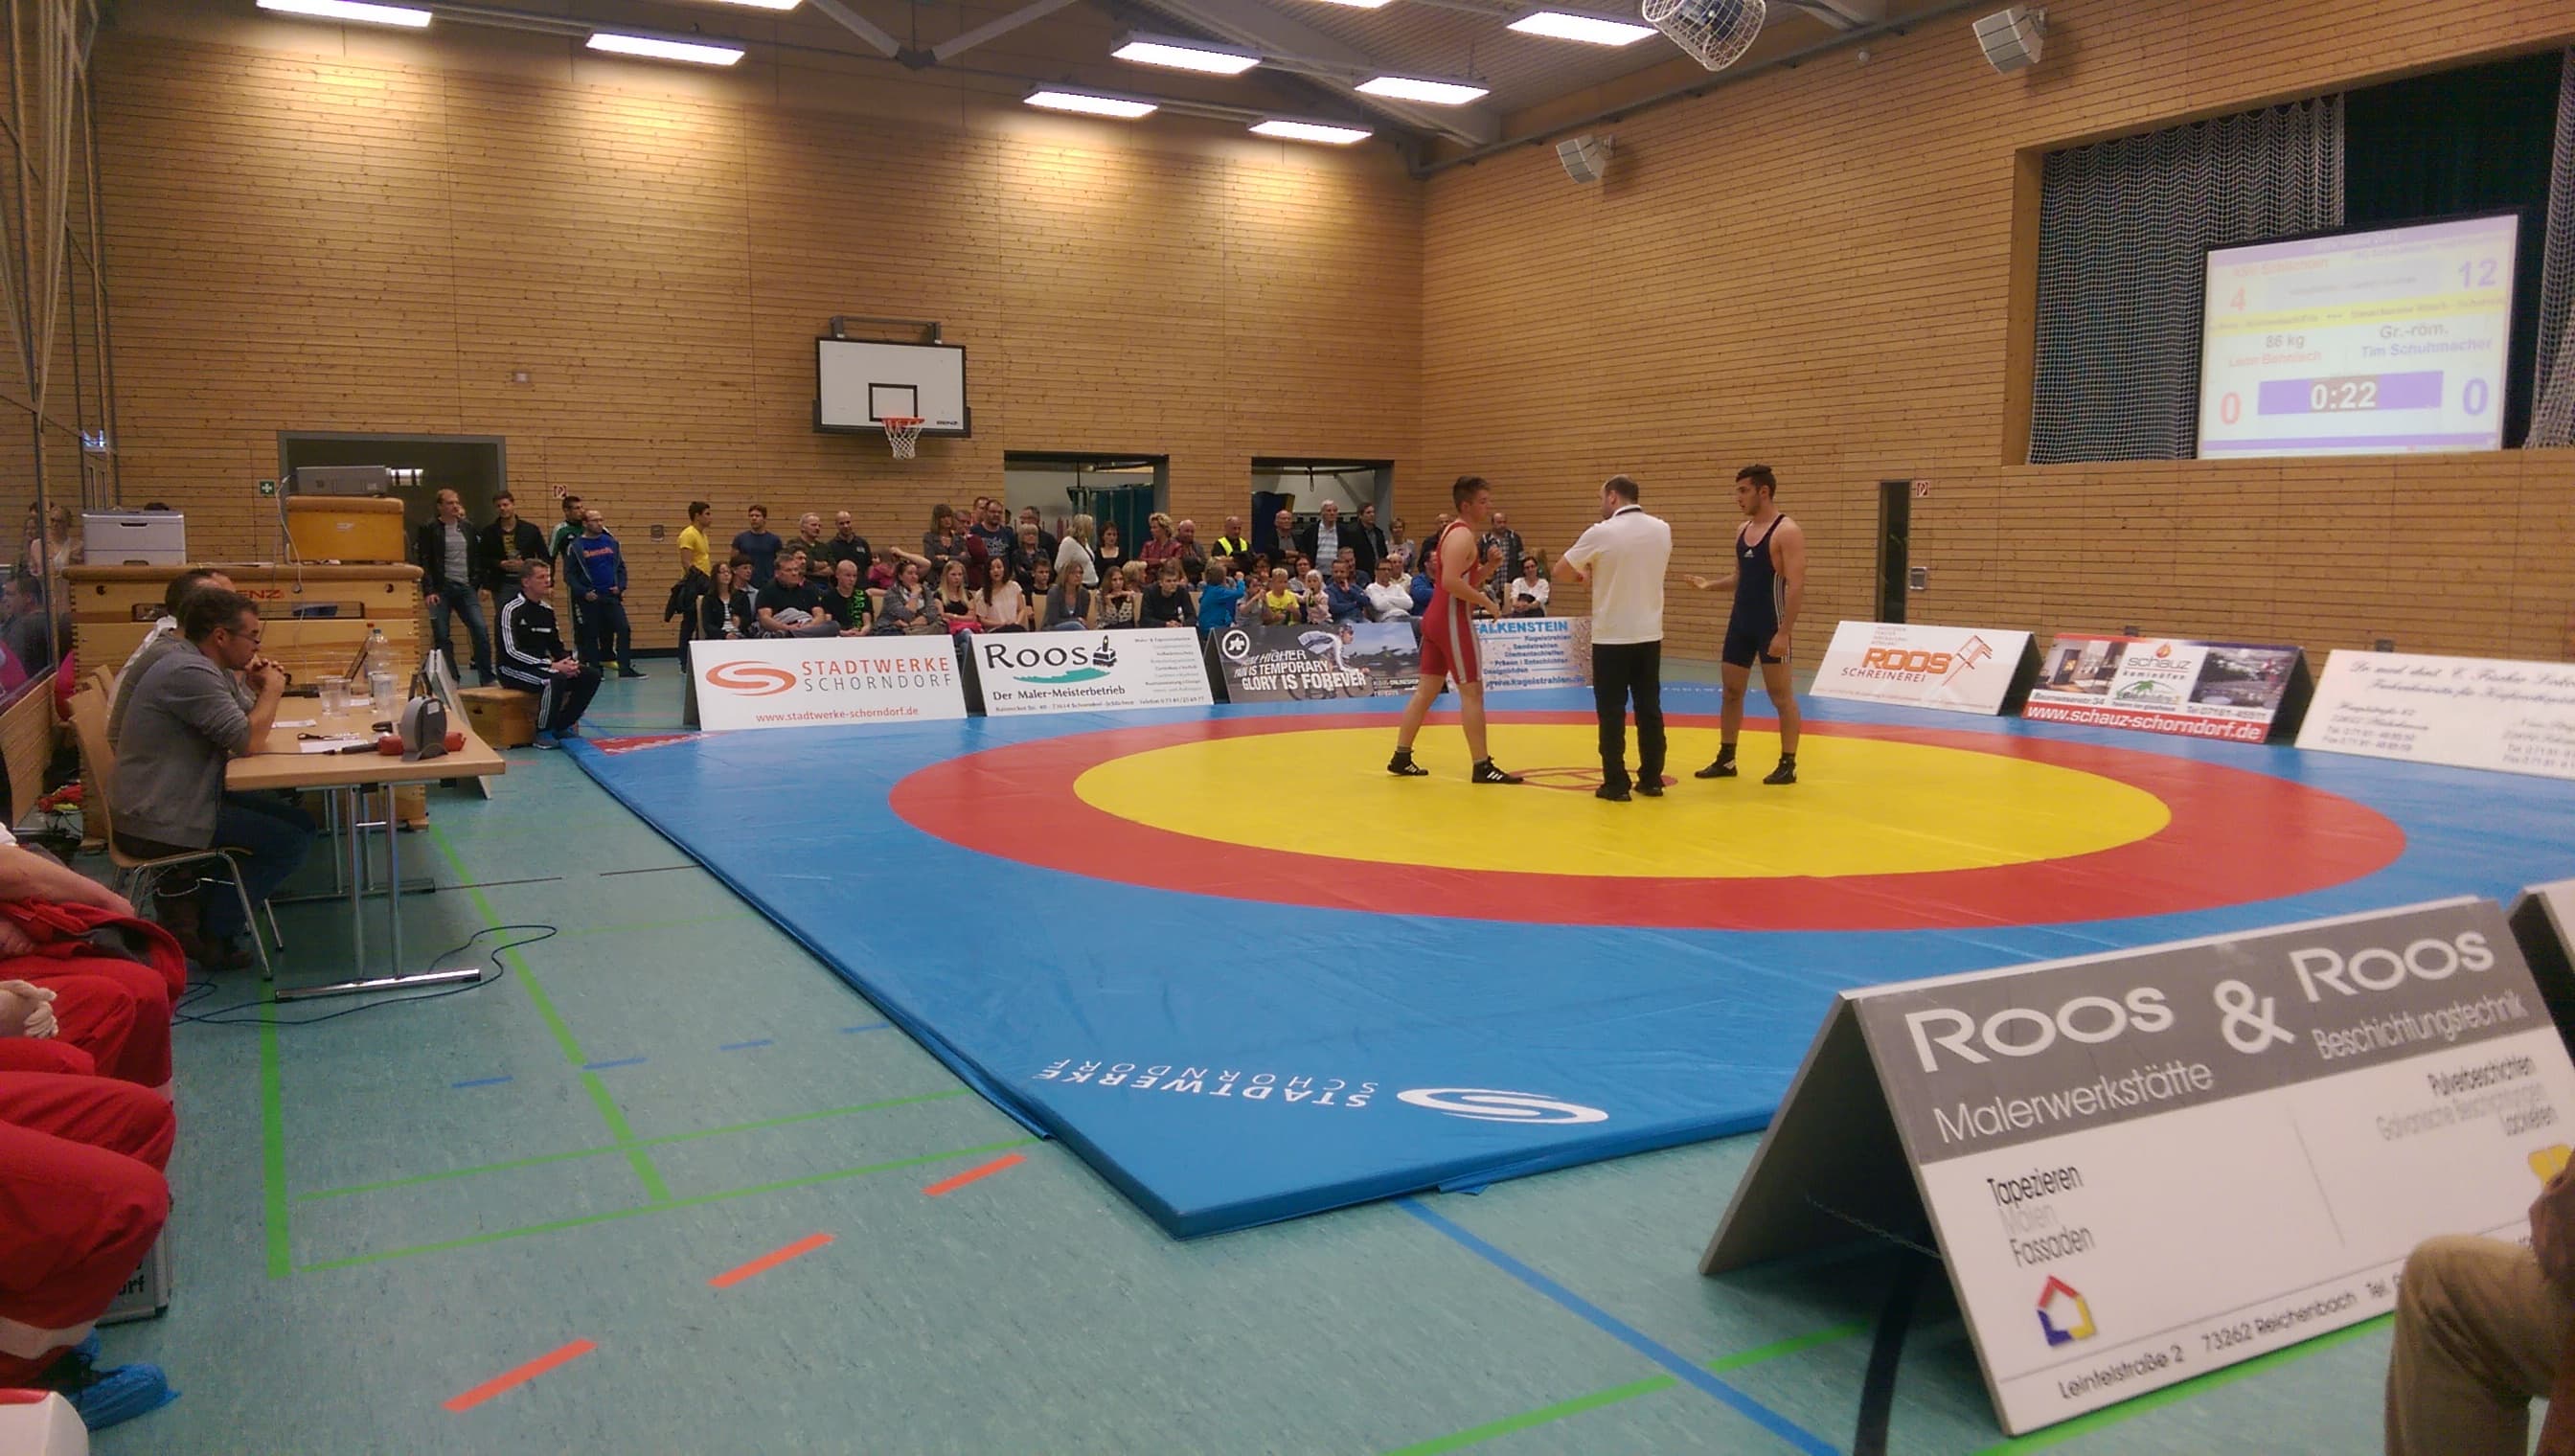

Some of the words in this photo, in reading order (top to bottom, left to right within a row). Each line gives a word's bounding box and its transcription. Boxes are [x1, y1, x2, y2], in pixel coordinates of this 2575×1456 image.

[2458, 258, 2497, 289] 12
[2230, 286, 2246, 312] 4
[2288, 333, 2305, 350] kg
[2380, 322, 2450, 339] Gr.-röm.
[2361, 345, 2386, 358] Tim
[2221, 392, 2242, 424] 0
[2311, 381, 2377, 410] 0:22
[2462, 377, 2489, 416] 0
[802, 657, 949, 676] STADTWERKE
[1248, 666, 1257, 676] IS
[1259, 660, 1329, 675] TEMPORARY
[1260, 649, 1307, 664] HIGHER
[1861, 648, 1953, 674] ROOS
[2127, 656, 2192, 670] schauz
[805, 673, 951, 692] SCHORNDORF
[1242, 675, 1278, 692] GLORY
[1282, 674, 1298, 690] IS
[1303, 671, 1366, 690] FOREVER
[1840, 667, 1926, 683] SCHREINEREI
[992, 690, 1012, 700] Der
[1017, 684, 1125, 700] Maler-Meisterbetrieb
[756, 706, 919, 723] www.stadtwerke-schorndorf.de
[2026, 707, 2271, 739] www.schauz-schorndorf.de
[2213, 979, 2296, 1054] &
[2312, 989, 2529, 1060] Beschichtungstechnik
[1032, 1068, 1372, 1108] STADTWERKE
[1051, 1058, 1379, 1094] SCHORNDORF
[1932, 1058, 2213, 1144] Malerwerkstätte
[1987, 1164, 2085, 1207] Tapezieren
[1999, 1199, 2058, 1233] Malen
[2009, 1224, 2095, 1268] Fassaden
[2170, 1345, 2184, 1364] 2
[2201, 1323, 2251, 1353] 73262
[2255, 1291, 2358, 1340] Reichenbach
